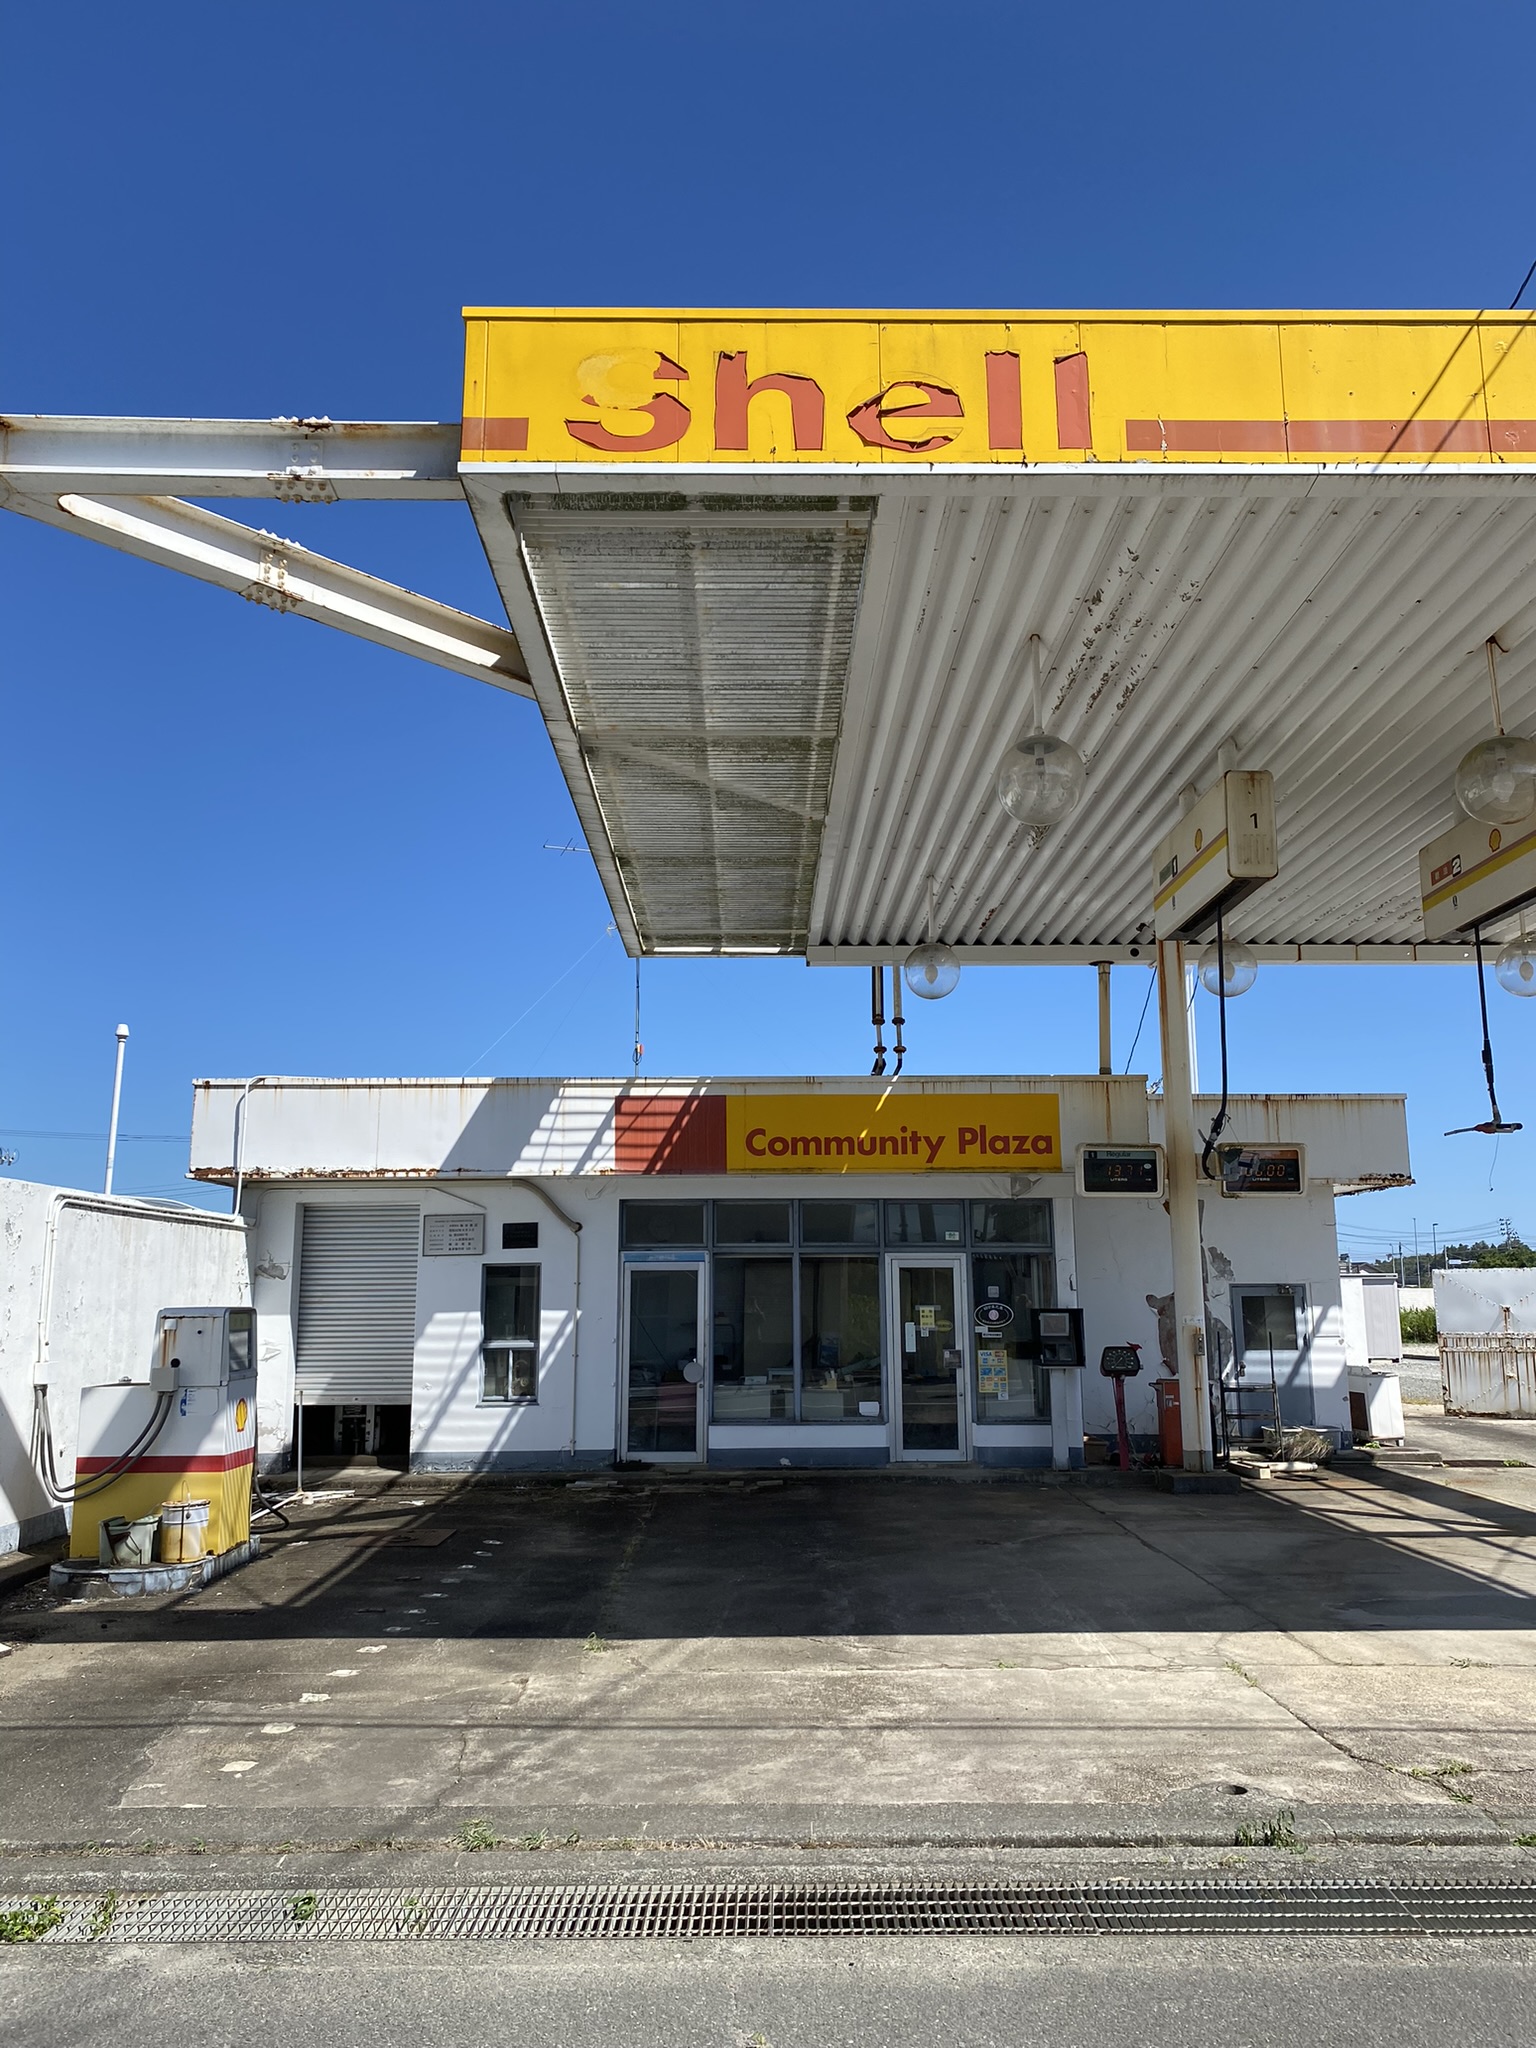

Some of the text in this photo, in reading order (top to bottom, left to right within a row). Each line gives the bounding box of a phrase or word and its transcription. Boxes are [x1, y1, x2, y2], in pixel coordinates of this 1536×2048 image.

[563, 348, 1093, 453] Shell
[1250, 813, 1258, 829] 1
[1452, 858, 1461, 875] 2
[745, 1124, 1053, 1164] Community Plaza
